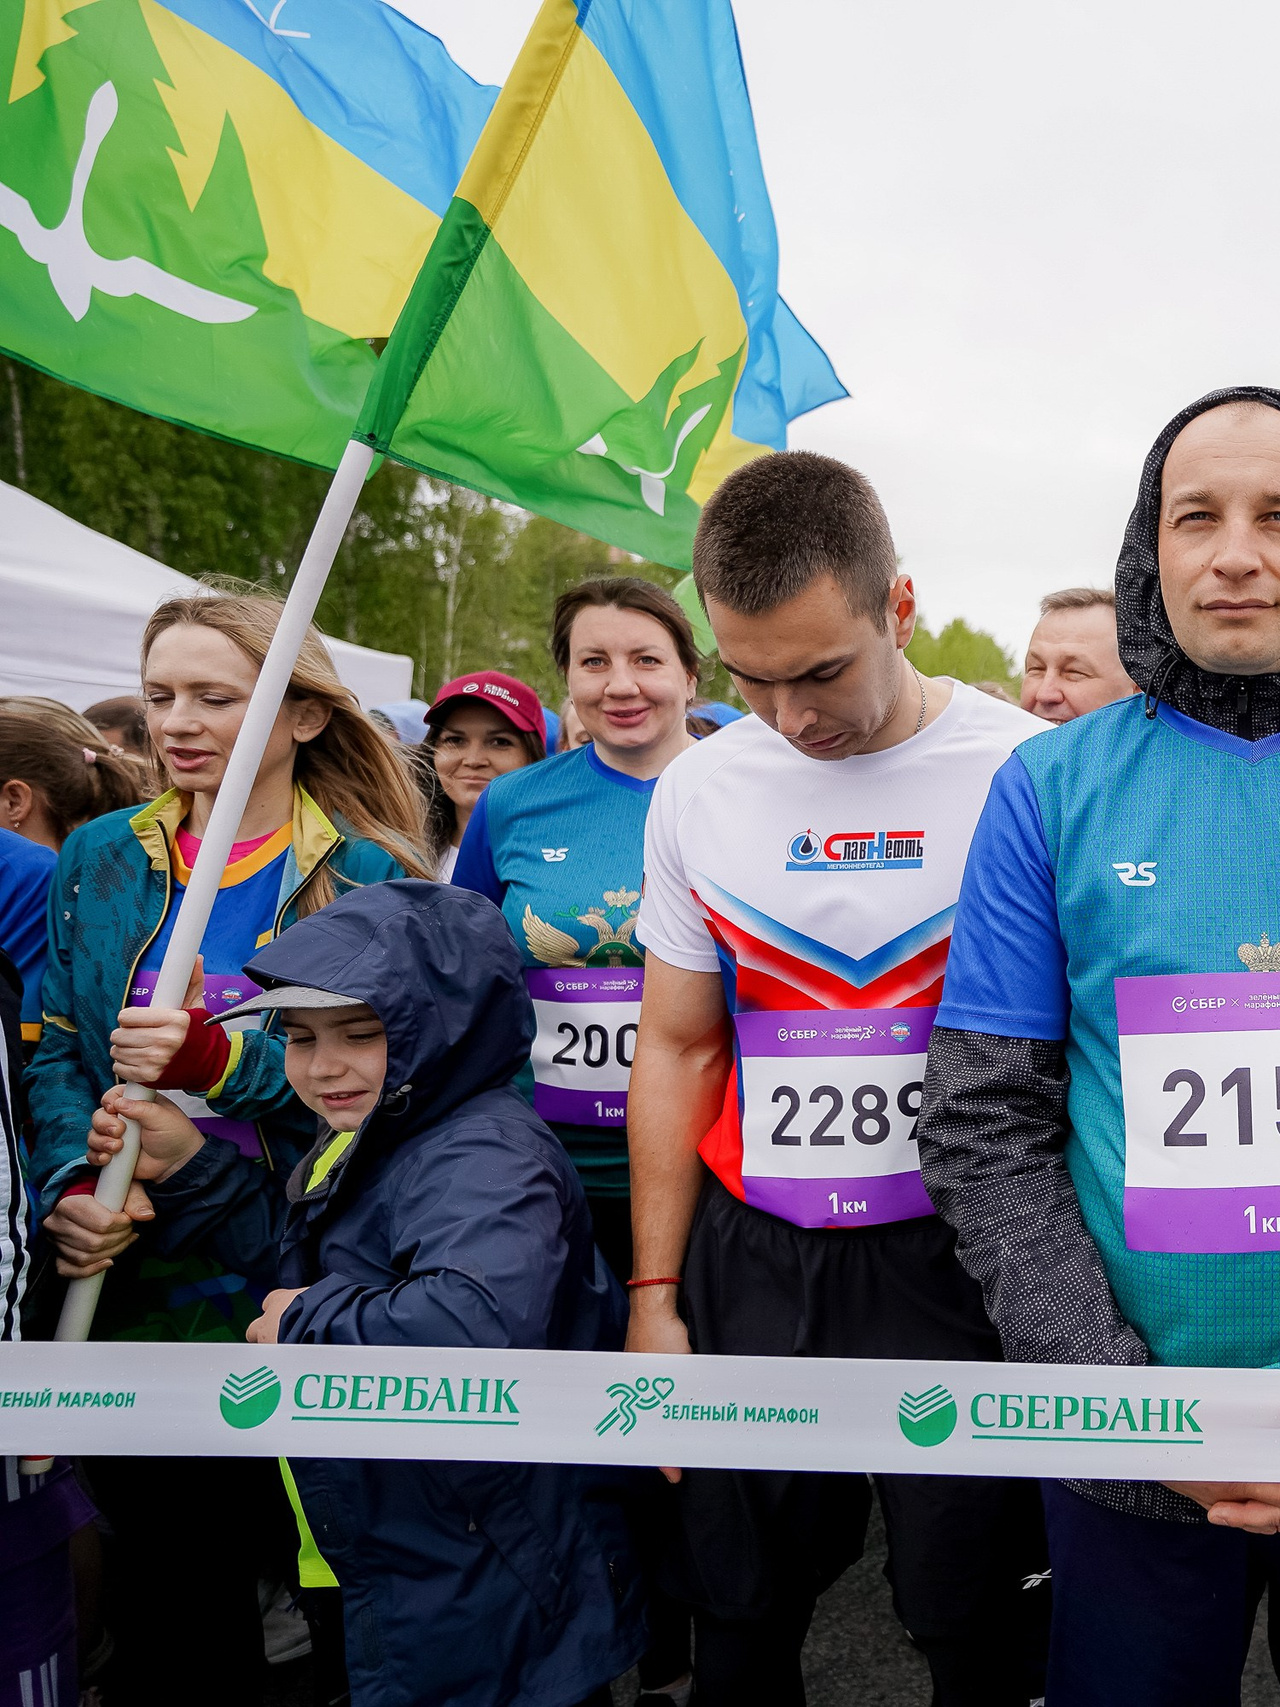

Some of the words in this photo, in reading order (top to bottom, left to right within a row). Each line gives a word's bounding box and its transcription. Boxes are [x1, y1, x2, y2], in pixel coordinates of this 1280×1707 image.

[131, 987, 150, 996] БЕР
[566, 982, 589, 990] СБЕР
[1189, 997, 1226, 1009] СБЕР
[789, 1030, 818, 1039] СБЕР
[552, 1022, 639, 1068] 200
[771, 1081, 923, 1146] 2289
[56, 1391, 136, 1408] МАРАФОН
[293, 1373, 520, 1414] СБЕРБАНК
[661, 1402, 738, 1422] ЗЕЛЕНЫЙ
[743, 1406, 819, 1424] МАРАФОН
[970, 1393, 1203, 1433] СБЕРБАНК
